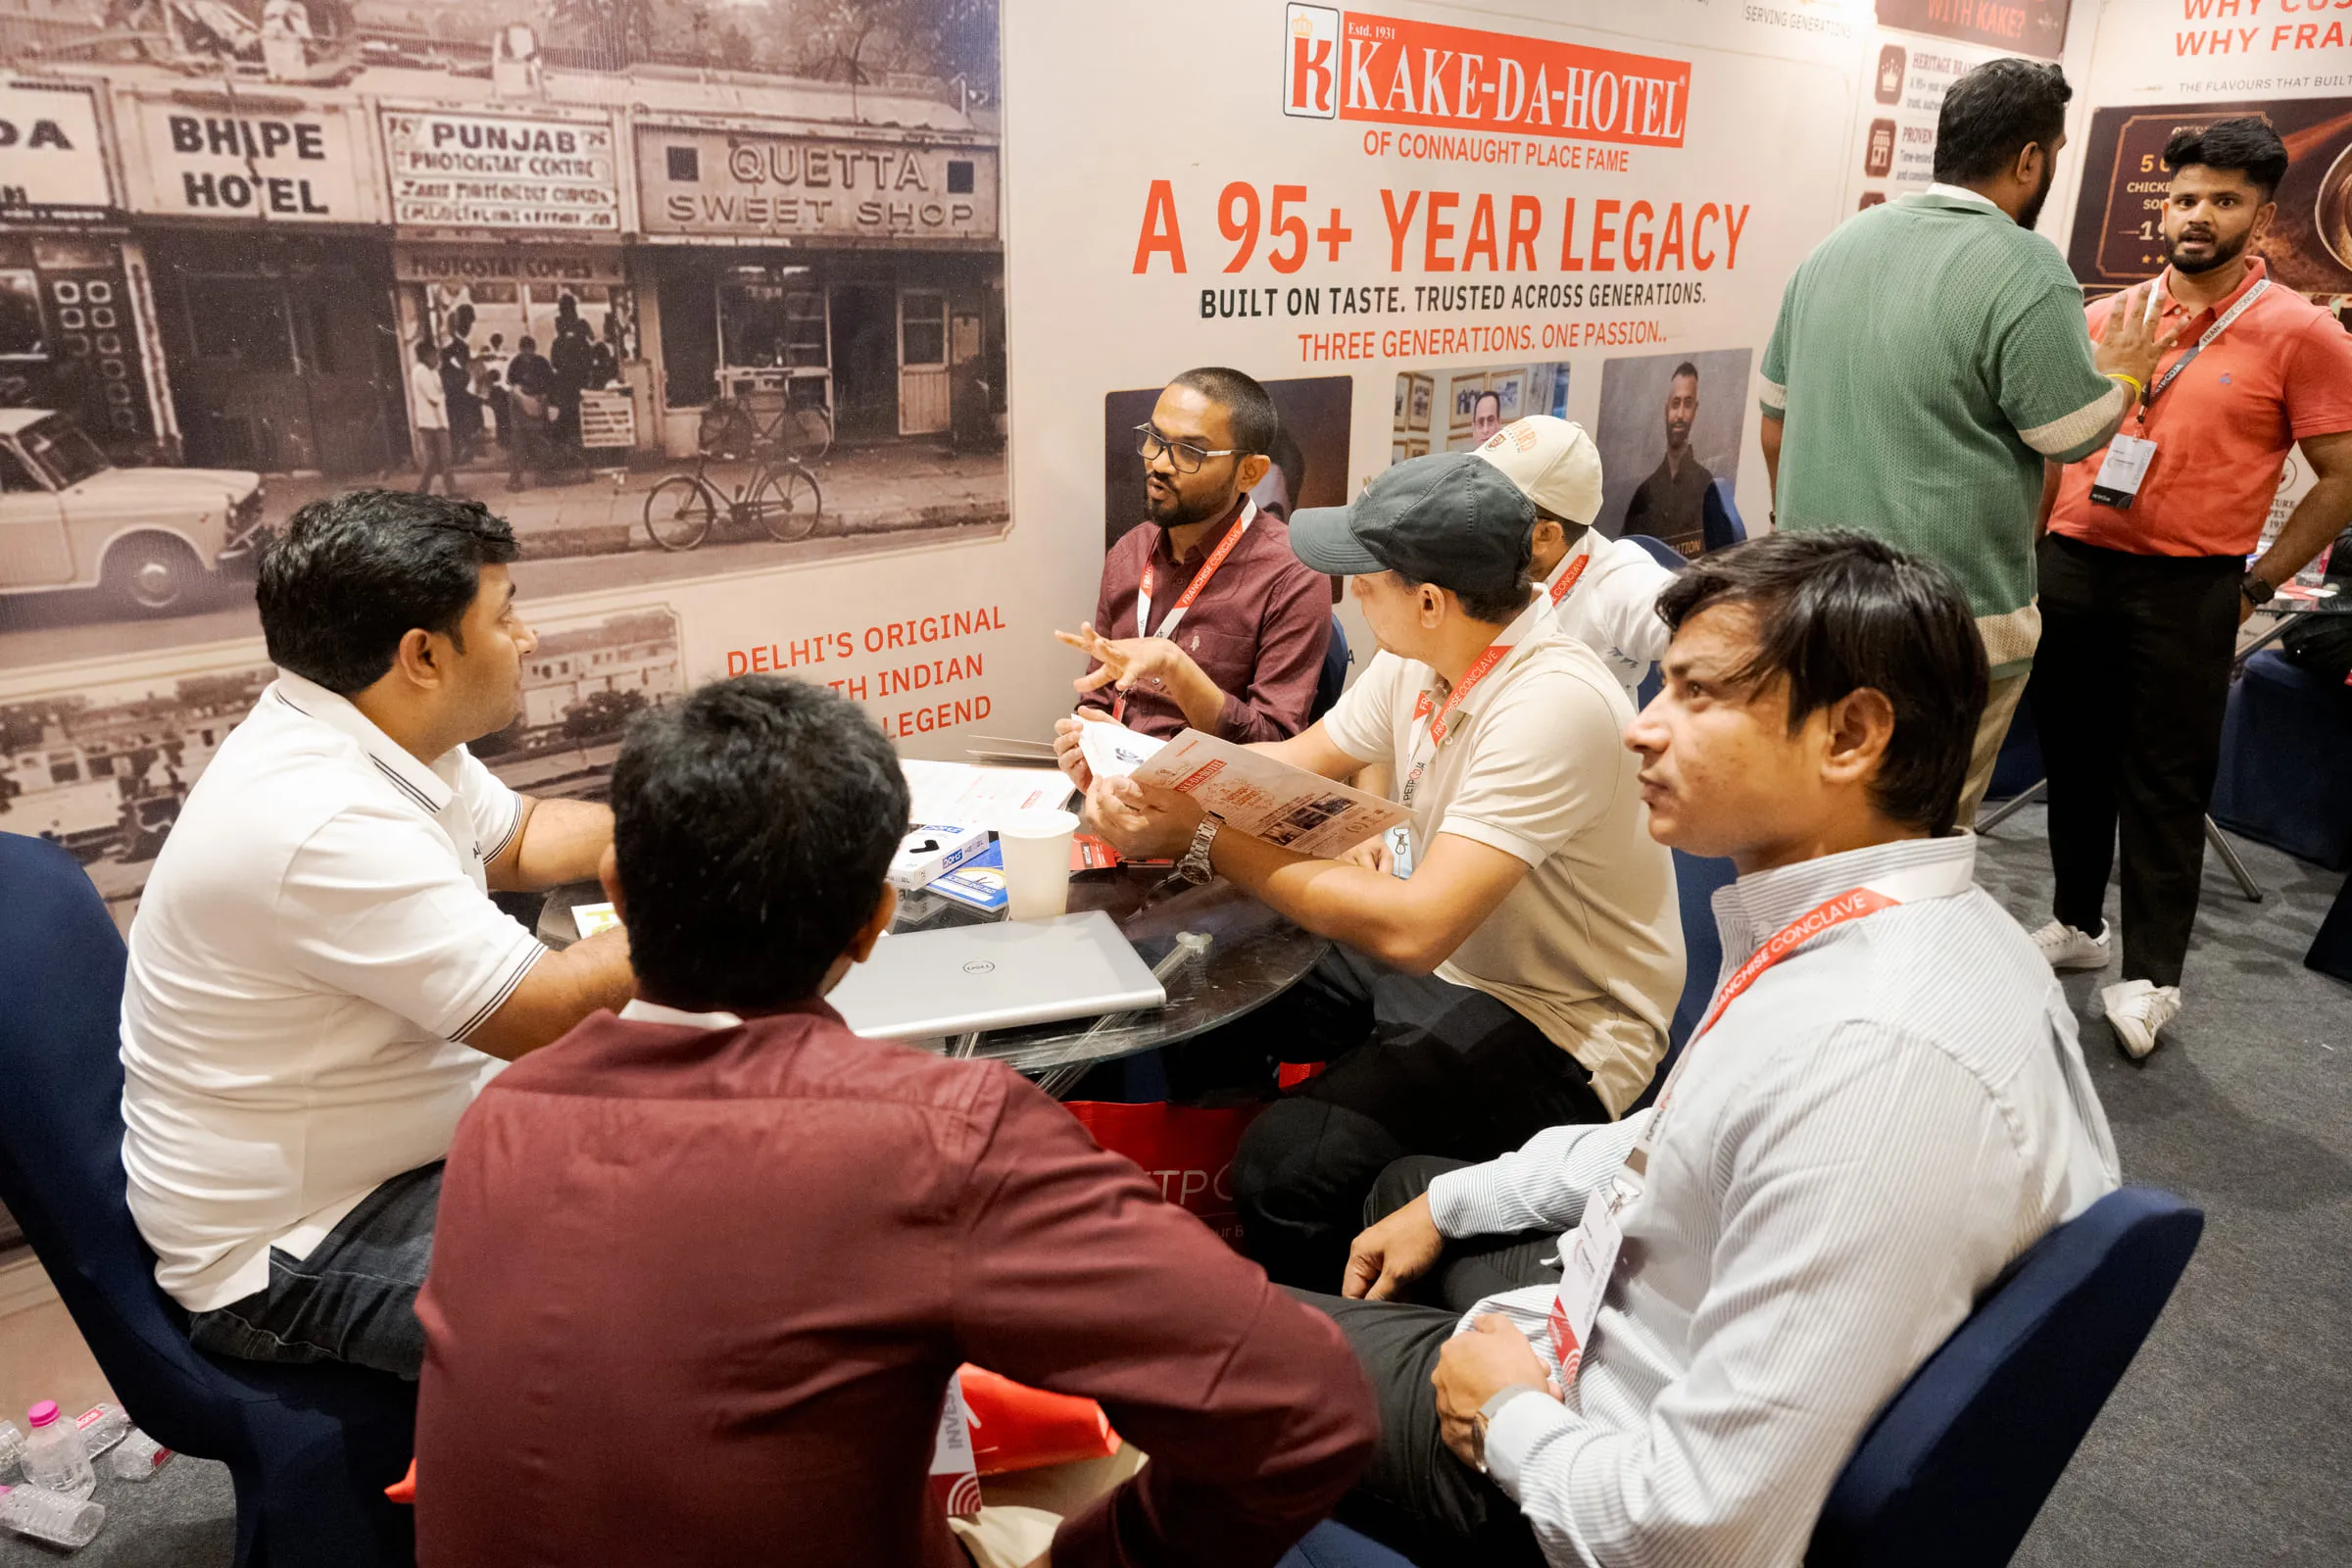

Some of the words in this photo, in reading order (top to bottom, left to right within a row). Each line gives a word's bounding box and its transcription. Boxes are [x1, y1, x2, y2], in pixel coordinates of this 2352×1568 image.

[1745, 5, 1788, 26] SERVING
[1975, 1, 2027, 39] KAKE?
[2183, 0, 2262, 20] WHY
[1348, 22, 1372, 37] Estd.
[1375, 25, 1396, 40] 1931
[2175, 27, 2260, 57] WHY
[2271, 22, 2352, 51] FRA
[1345, 38, 1684, 139] KAKE-DA-HOTEL
[2179, 81, 2203, 93] THE
[2205, 78, 2272, 93] FLAVOURS
[2276, 76, 2311, 89] THAT
[2314, 74, 2352, 87] BUILT
[431, 122, 576, 154] PUNJAB
[1363, 129, 1393, 157] OF
[1398, 132, 1522, 165] CONNAUGHT
[1525, 142, 1582, 170] PLACE
[1586, 148, 1630, 172] FAME
[728, 144, 929, 192] QUETTA
[2127, 181, 2171, 193] CHICKE
[666, 194, 832, 224] SWEET
[856, 200, 973, 228] SHOP
[1132, 179, 1188, 274] A
[1217, 181, 1352, 274] 95+
[1379, 189, 1543, 272] YEAR
[1560, 197, 1750, 272] LEGACY
[1200, 288, 1278, 318] BUILT
[1286, 287, 1320, 316] ON
[1329, 287, 1405, 315] TASTE.
[1415, 284, 1505, 312] TRUSTED
[1511, 283, 1584, 309] ACROSS
[1589, 282, 1706, 308] GENERATIONS.
[1298, 331, 1376, 363] THREE
[1383, 324, 1536, 359] GENERATIONS.
[1542, 323, 1580, 348] ONE
[1182, 564, 1214, 605] FRANCHISE
[1209, 527, 1241, 566] CONCLAVE
[727, 632, 854, 677] DELHI'S
[864, 606, 1005, 654] ORIGINAL
[879, 653, 984, 697] INDIAN
[1458, 650, 1498, 698] CONCLAVE
[882, 695, 992, 740] LEGEND
[1771, 893, 1867, 954] CONCLAVE
